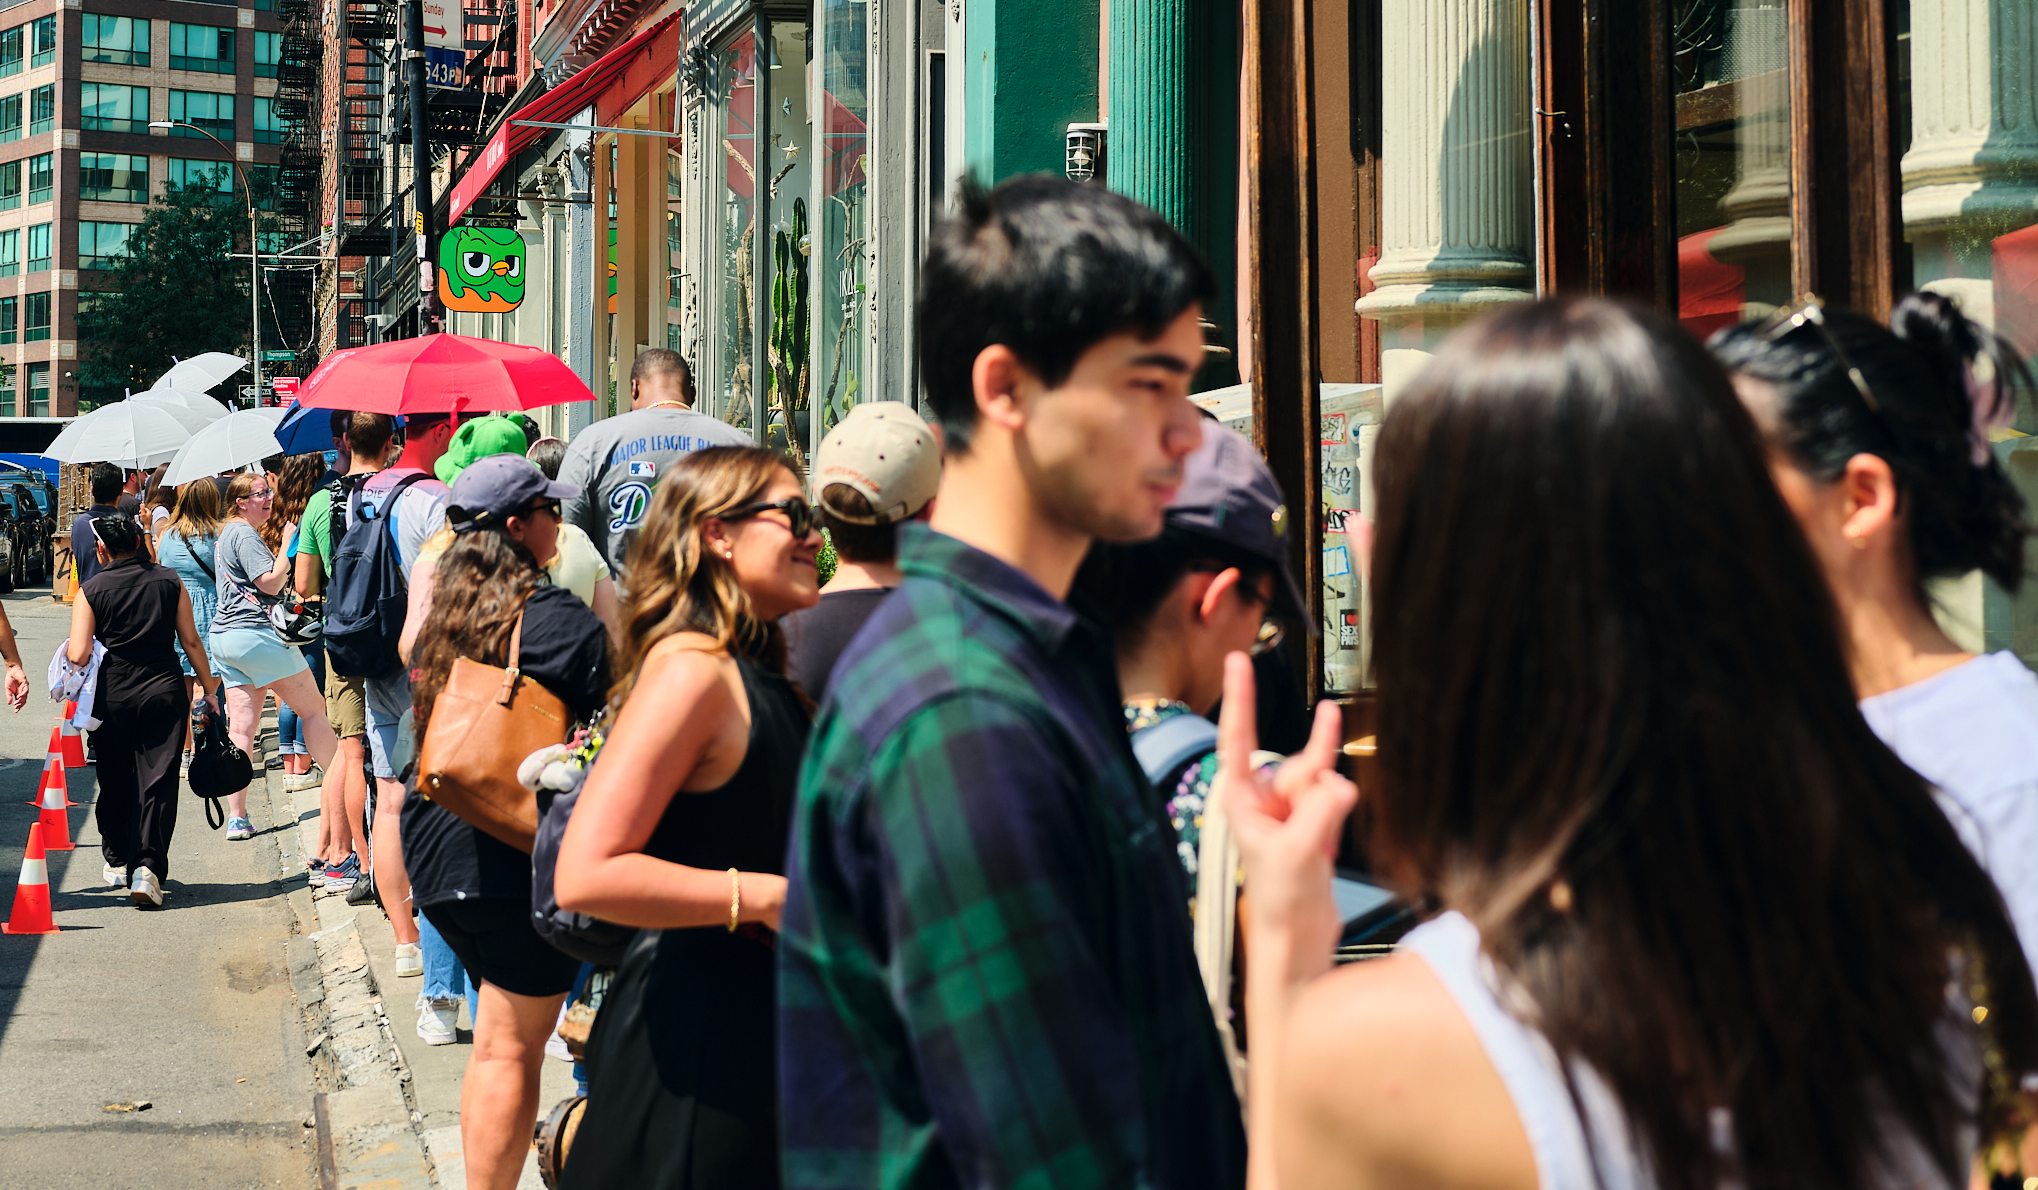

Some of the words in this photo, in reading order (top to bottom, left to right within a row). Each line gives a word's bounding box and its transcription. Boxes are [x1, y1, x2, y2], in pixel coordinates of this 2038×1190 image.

[424, 1, 444, 19] Sunday
[611, 438, 647, 466] MAJOR
[651, 435, 692, 453] LEAGUE
[1341, 614, 1345, 626] I
[1341, 626, 1358, 636] SEX
[1341, 636, 1359, 646] PAYS
